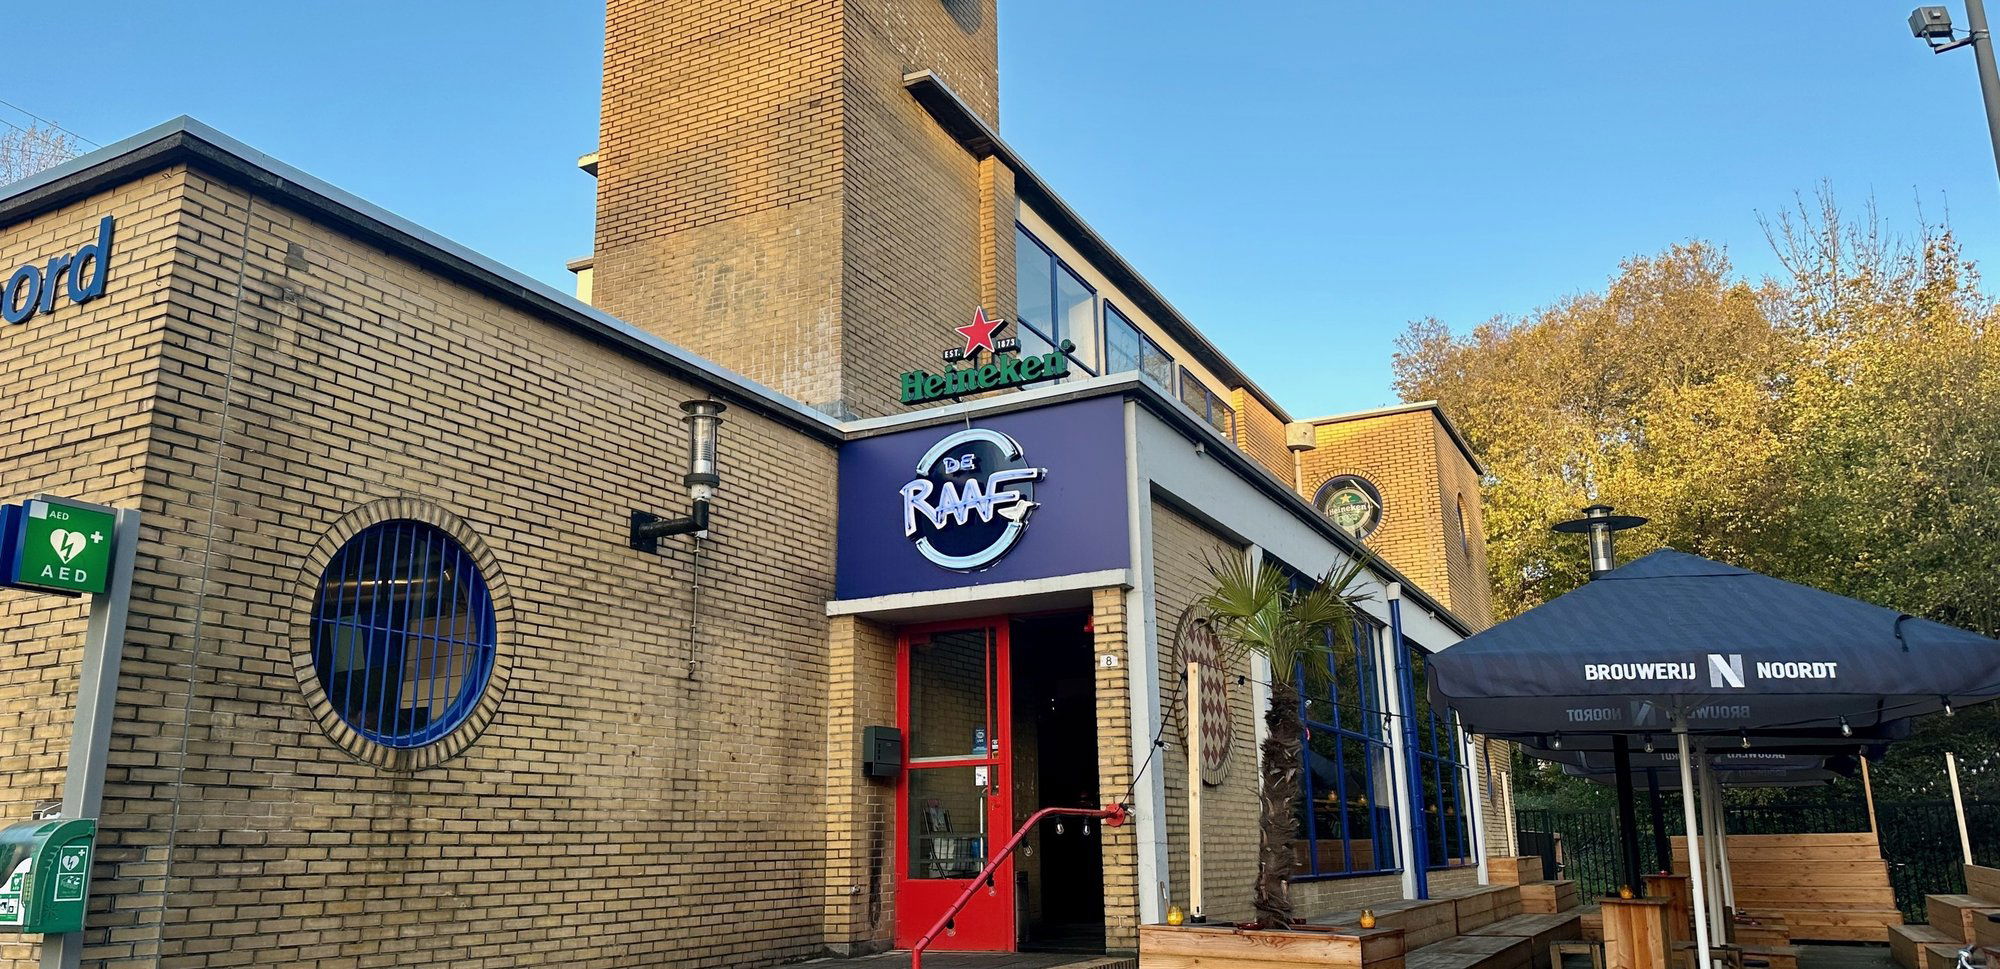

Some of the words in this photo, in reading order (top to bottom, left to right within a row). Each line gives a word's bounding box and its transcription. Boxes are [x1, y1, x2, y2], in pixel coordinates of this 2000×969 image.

[0, 215, 113, 324] ord
[944, 348, 961, 359] EST.
[997, 338, 1015, 348] 1873
[900, 351, 1068, 402] Heineken
[943, 454, 975, 474] DE
[900, 468, 1038, 537] RAAF
[1329, 503, 1367, 516] Heineken
[49, 511, 69, 520] AED
[41, 565, 87, 582] AED
[1106, 656, 1112, 665] 8
[1584, 662, 1696, 680] BROUWERIJ
[1707, 654, 1745, 688] N
[1756, 662, 1837, 679] NOORDT
